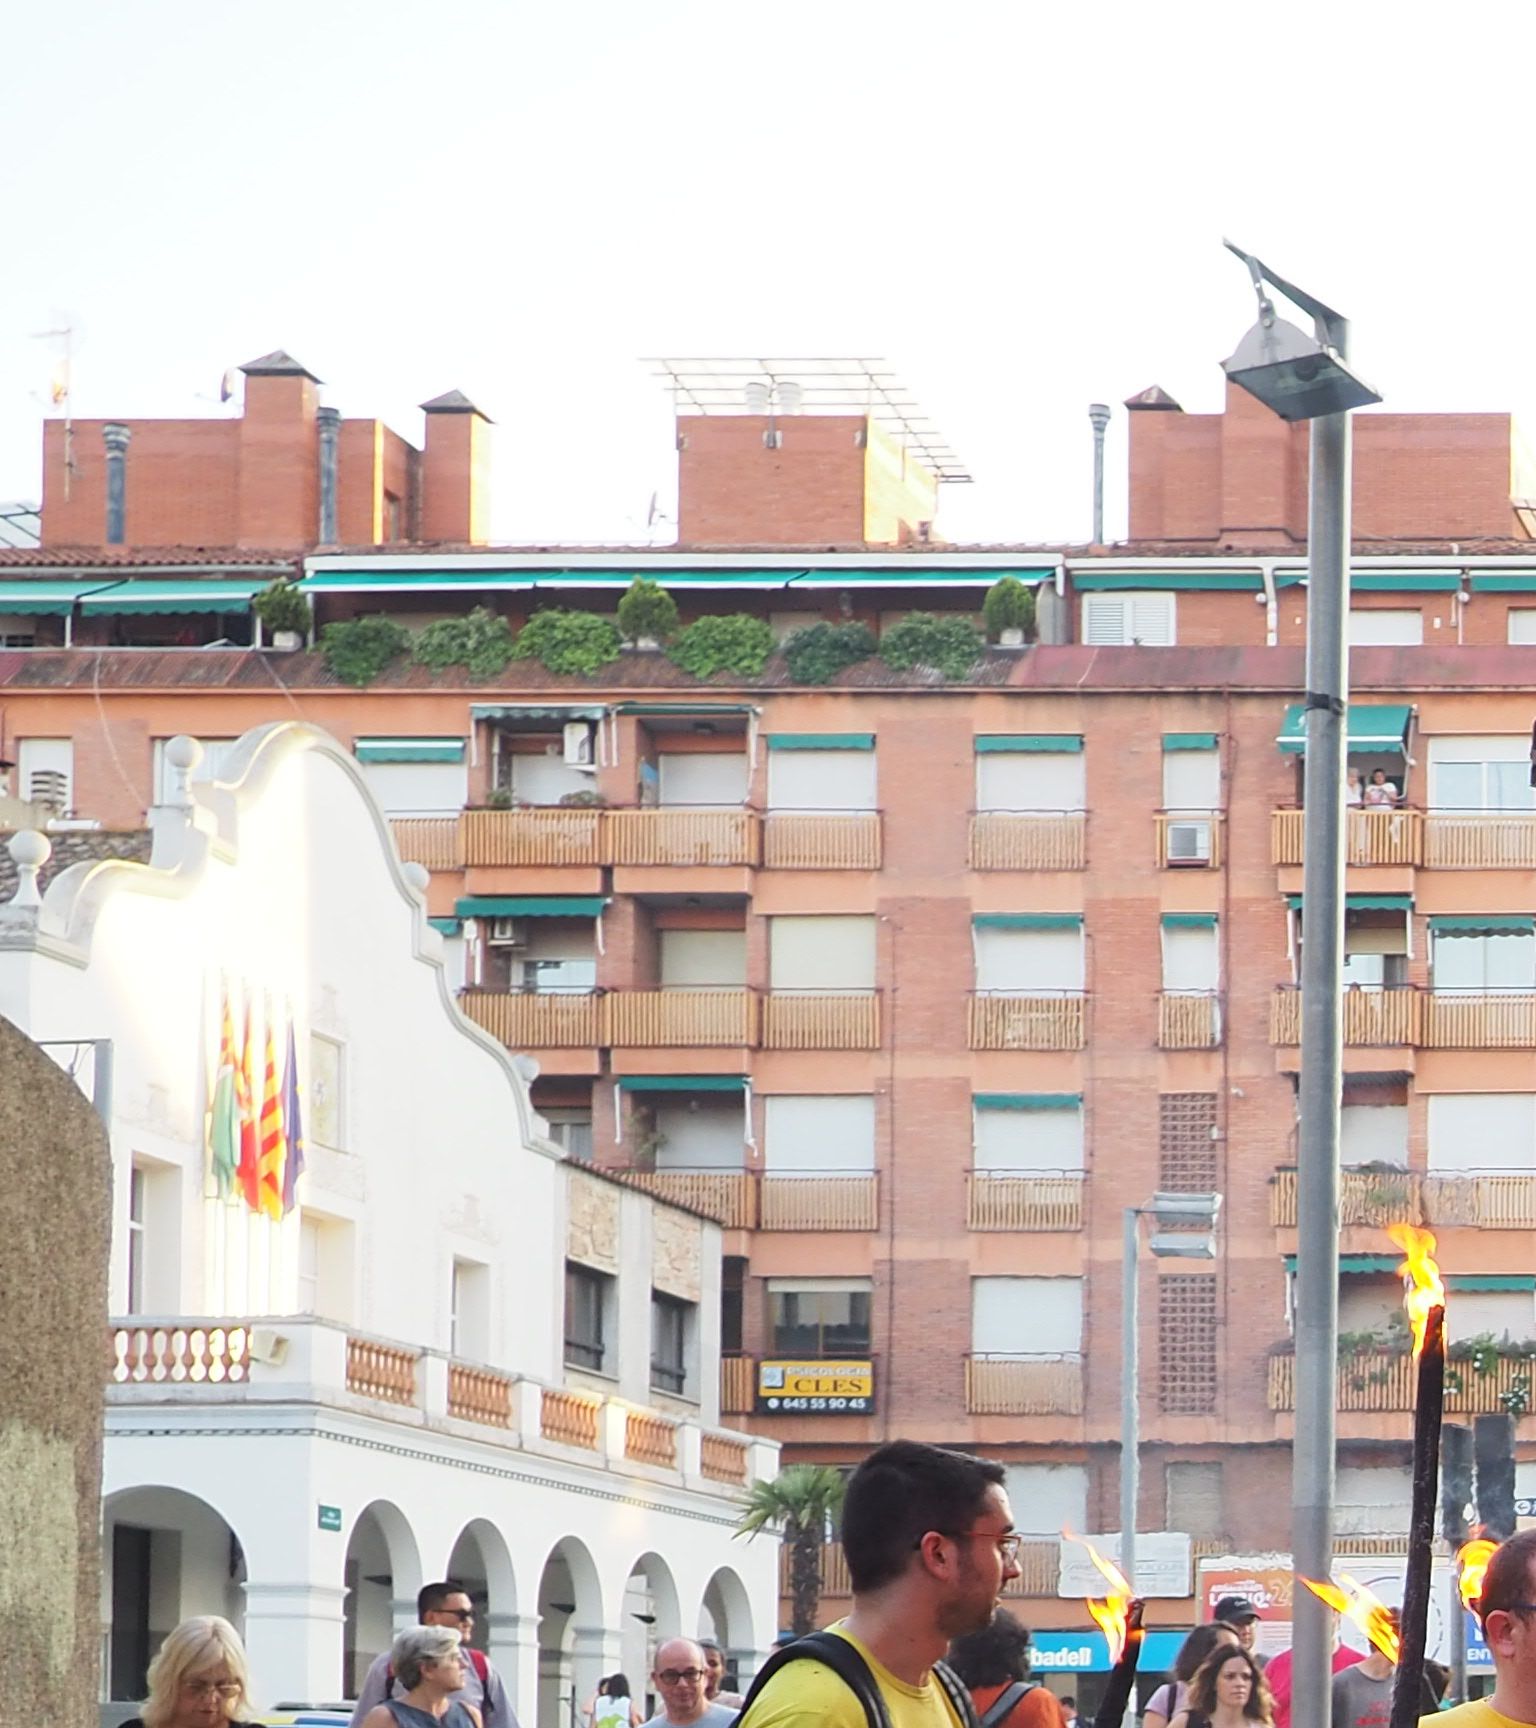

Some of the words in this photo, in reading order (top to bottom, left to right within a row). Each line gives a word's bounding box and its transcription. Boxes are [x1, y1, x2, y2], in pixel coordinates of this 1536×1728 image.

[793, 1379, 863, 1394] CLES
[782, 1398, 807, 1409] 645
[809, 1398, 827, 1409] 55
[828, 1398, 846, 1409] 90
[848, 1398, 866, 1409] 45
[1029, 1647, 1092, 1667] badell
